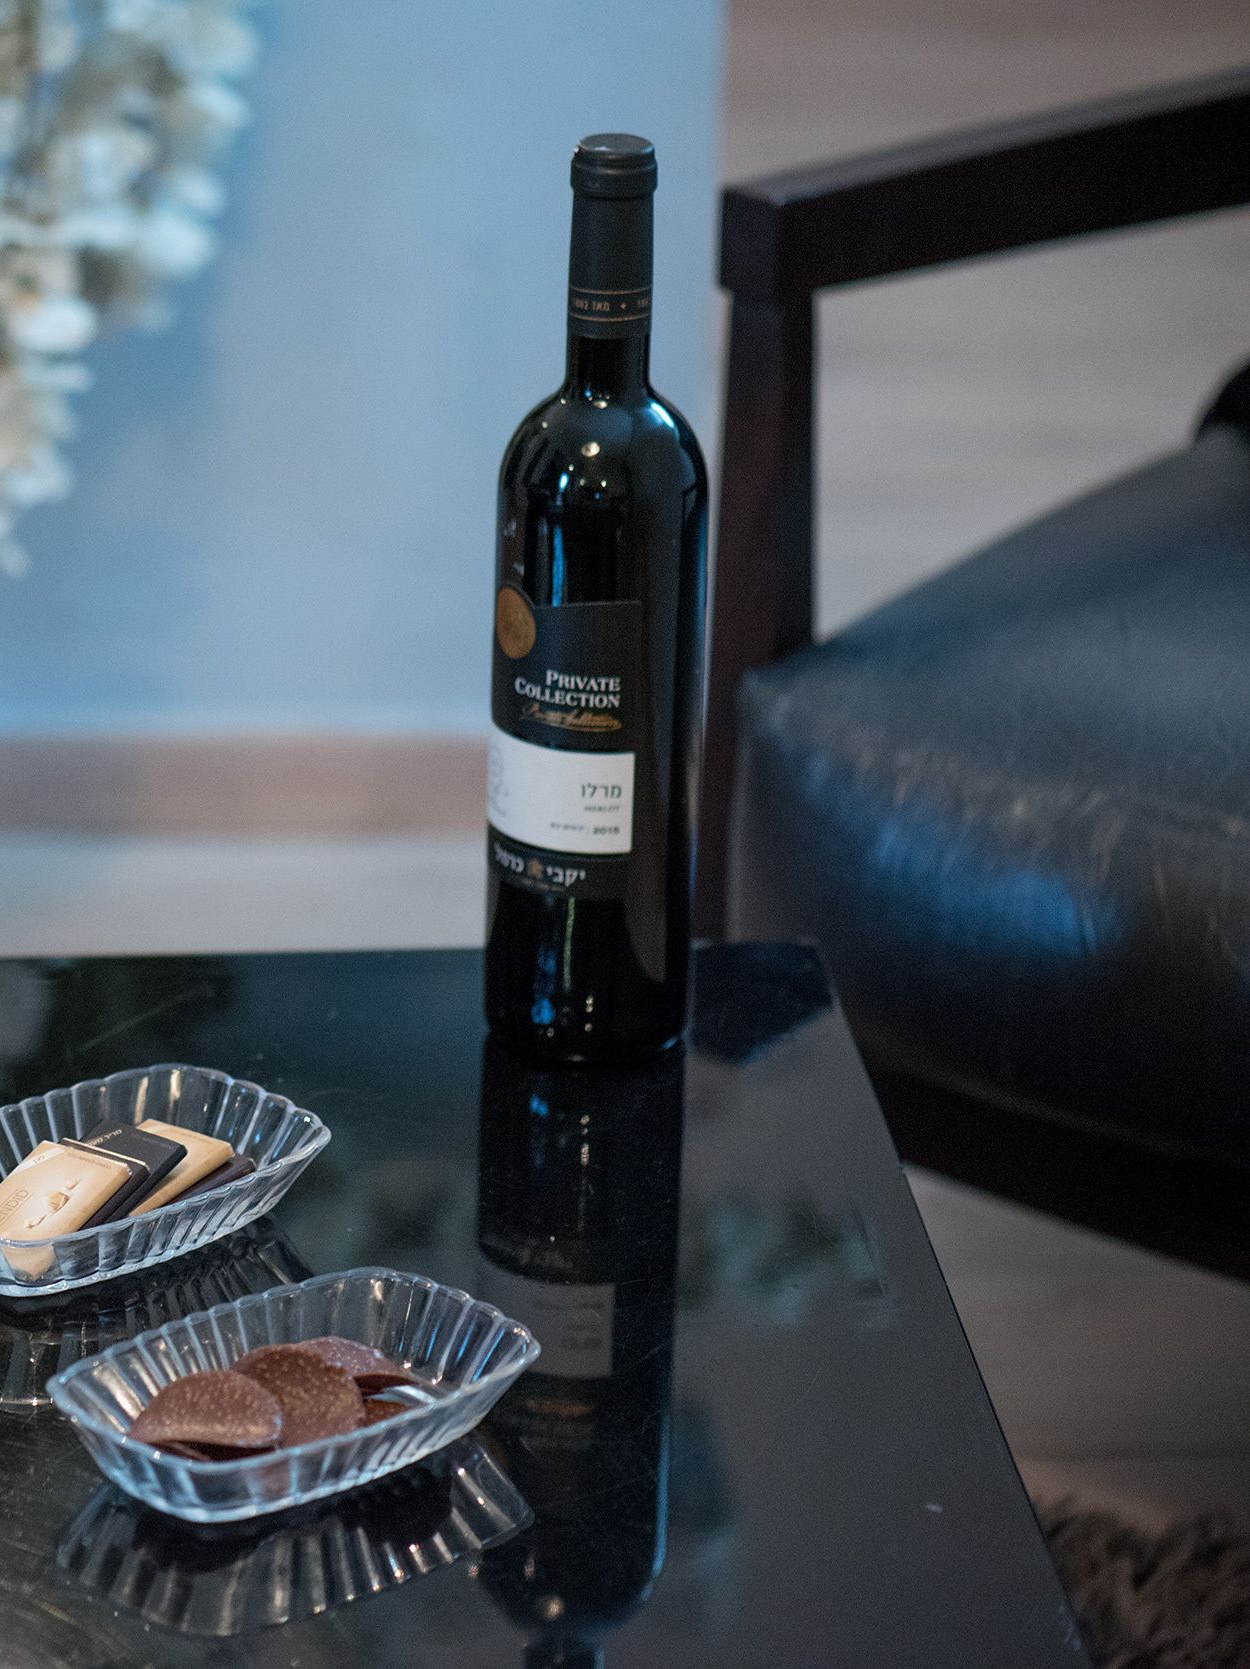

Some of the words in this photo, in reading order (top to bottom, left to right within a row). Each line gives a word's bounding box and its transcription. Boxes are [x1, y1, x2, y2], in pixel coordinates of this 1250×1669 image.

[546, 669, 621, 692] PRIVATE
[513, 677, 620, 708] COLLECTION
[581, 783, 622, 798] מרלו
[546, 866, 586, 887] יקבי
